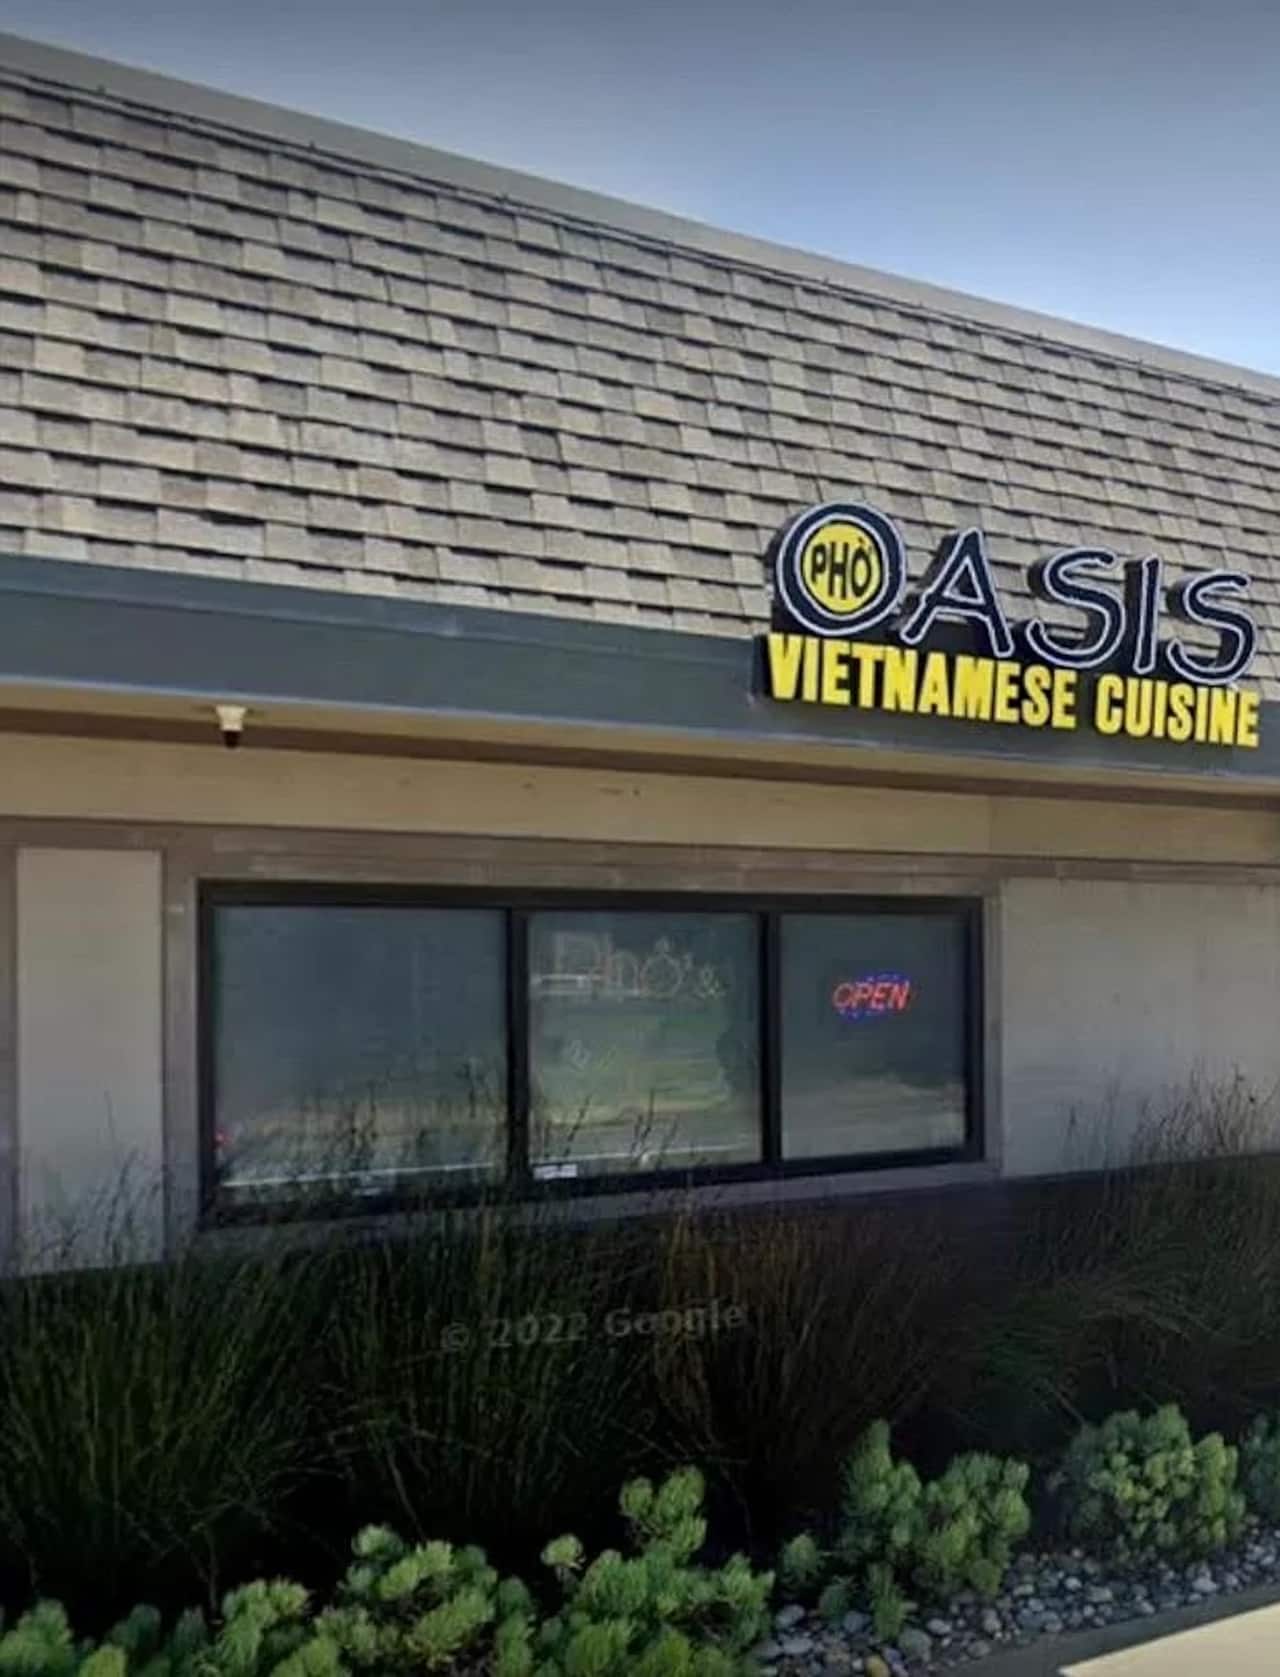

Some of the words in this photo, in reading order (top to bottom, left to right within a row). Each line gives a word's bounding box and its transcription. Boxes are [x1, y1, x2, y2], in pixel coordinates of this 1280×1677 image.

[773, 501, 1257, 685] OASIS
[767, 633, 1077, 729] VIETNAMESE
[1094, 676, 1260, 748] CUISINE
[832, 980, 911, 1010] OPEN
